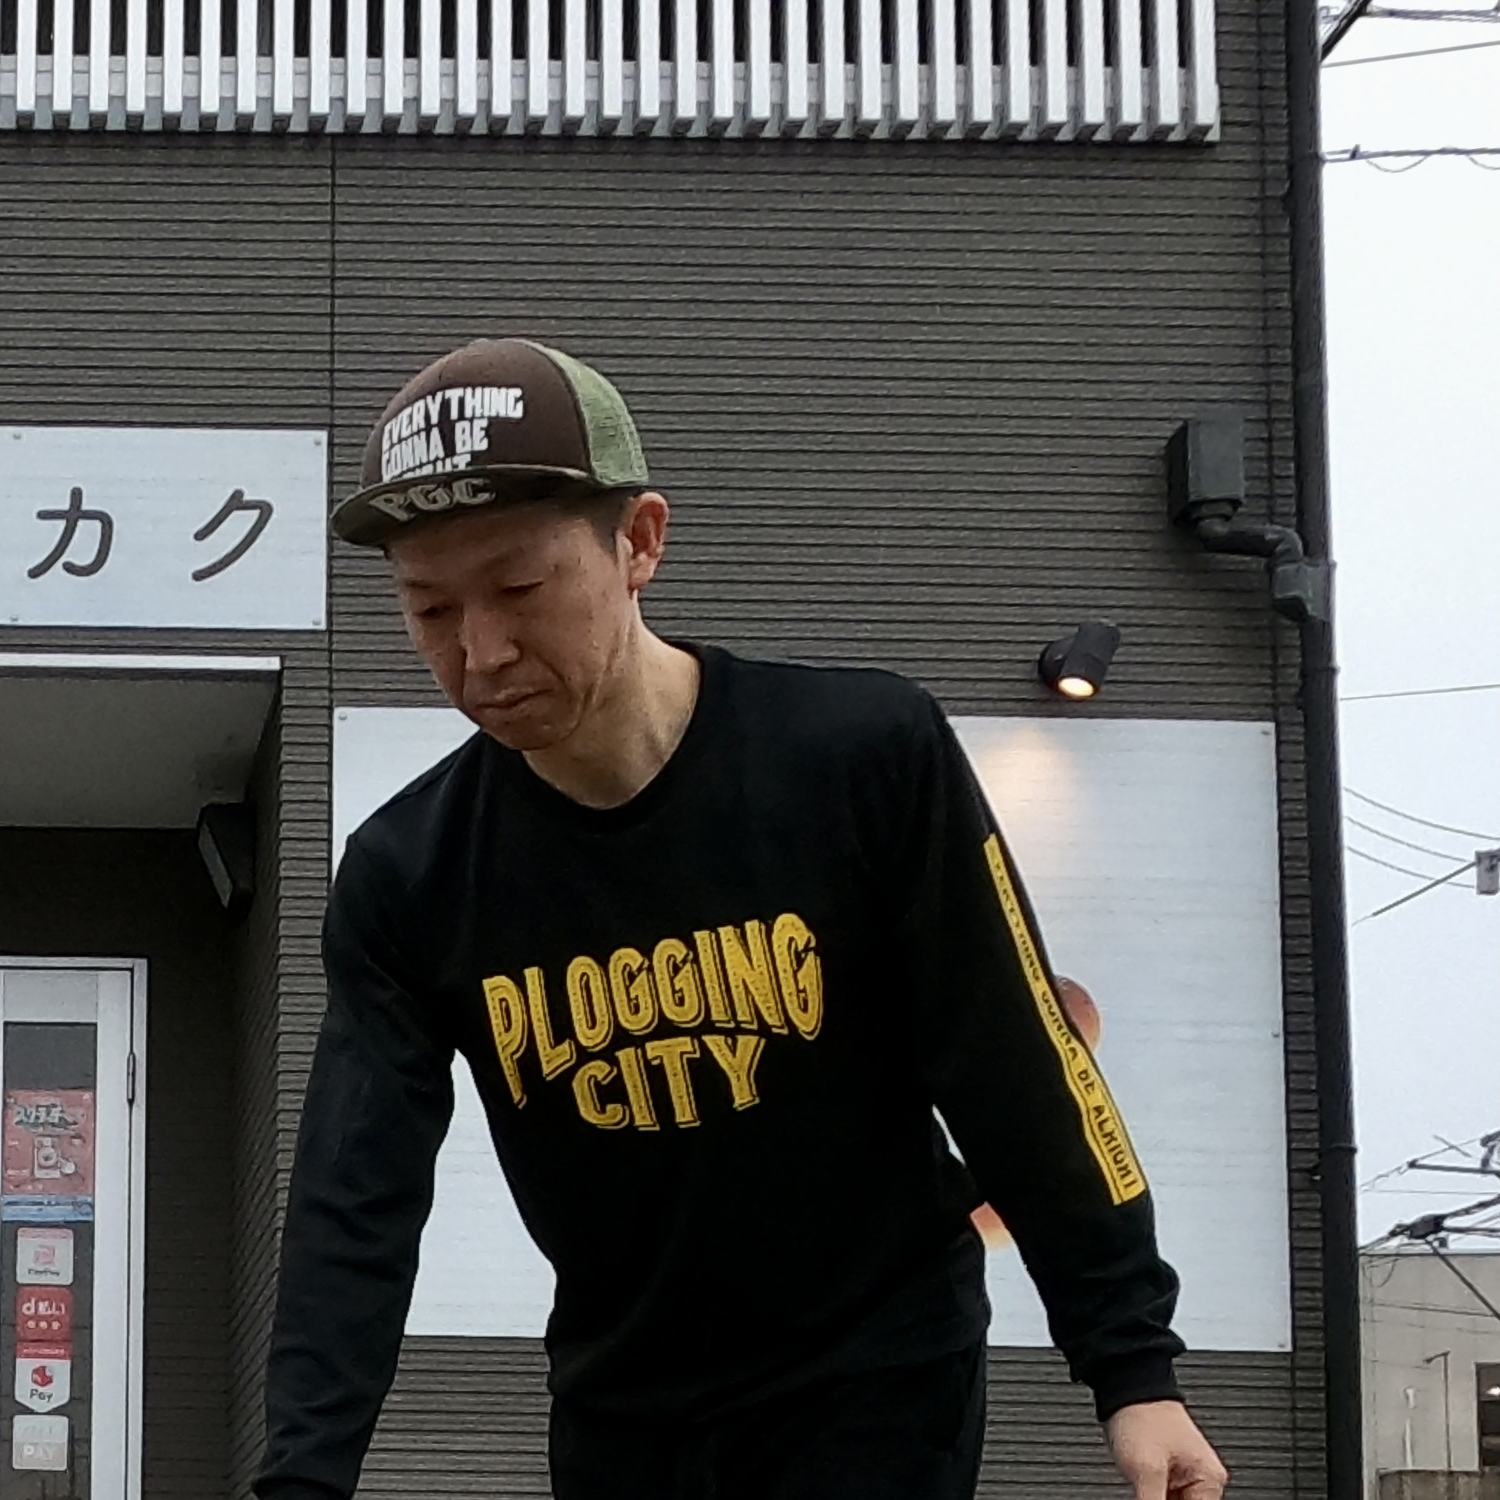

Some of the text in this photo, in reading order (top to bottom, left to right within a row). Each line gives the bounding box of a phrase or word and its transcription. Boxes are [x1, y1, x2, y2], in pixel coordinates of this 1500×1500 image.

[381, 386, 525, 450] EVERYTHING
[381, 426, 446, 483] GONNA
[454, 417, 489, 455] BE
[482, 912, 824, 1110] PLOGGING
[571, 1035, 767, 1132] CITY
[29, 1388, 54, 1404] Pay
